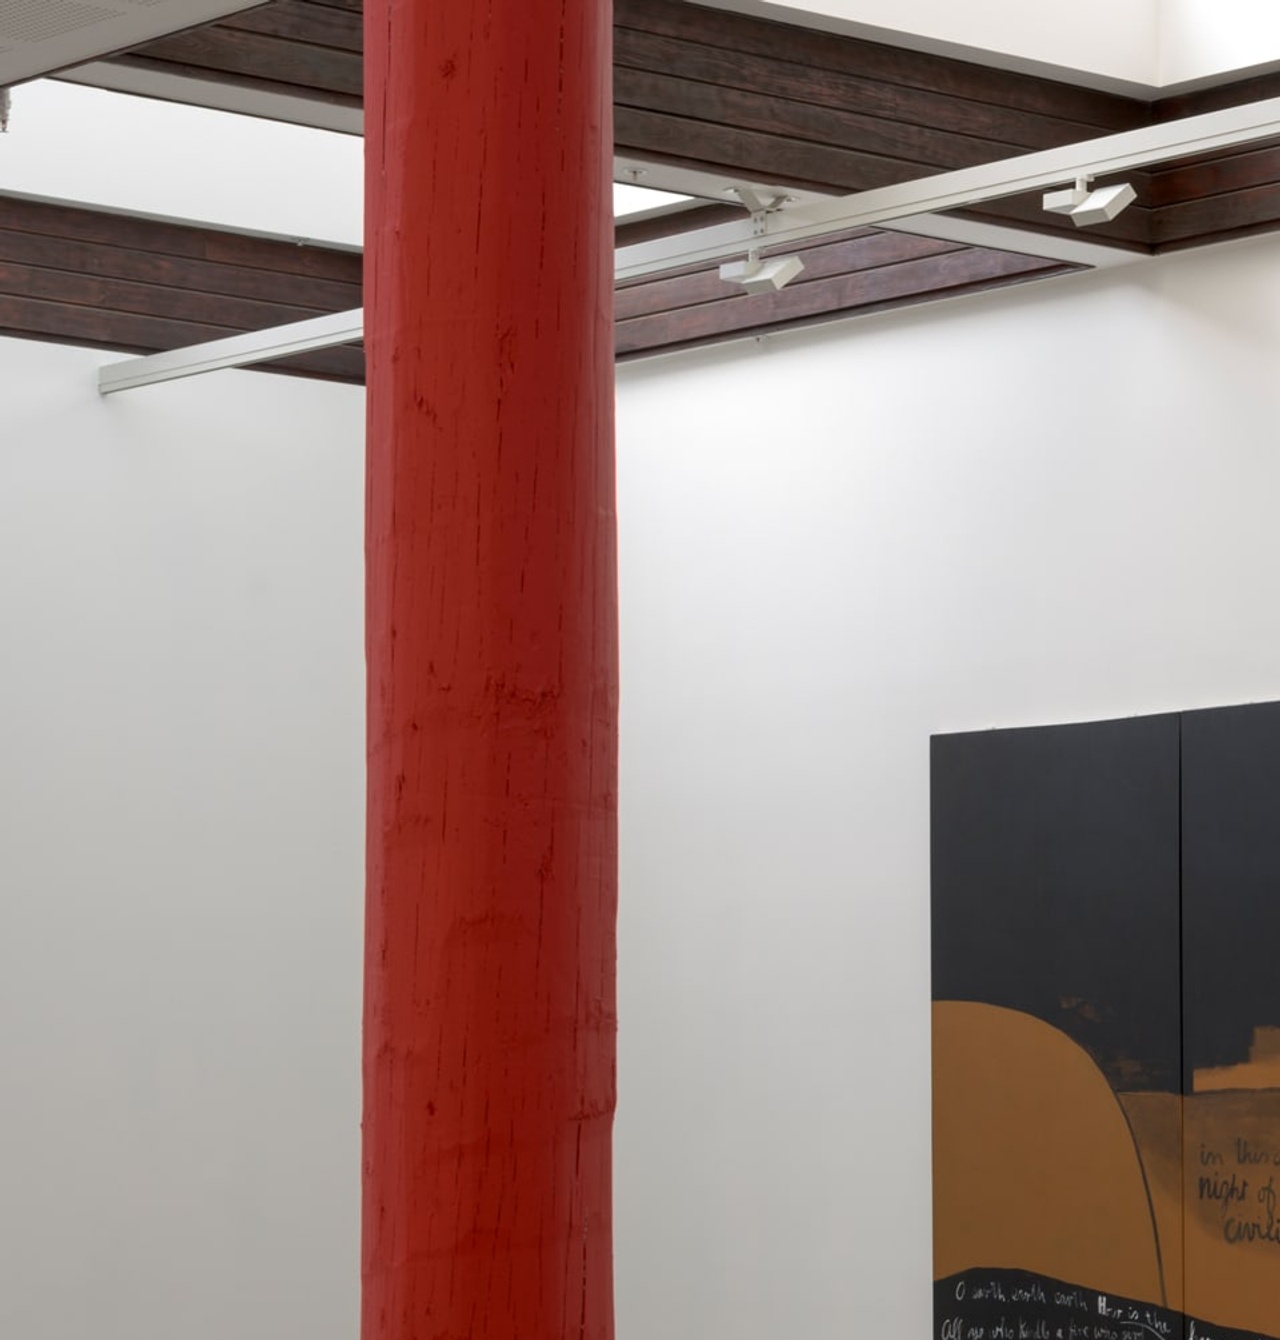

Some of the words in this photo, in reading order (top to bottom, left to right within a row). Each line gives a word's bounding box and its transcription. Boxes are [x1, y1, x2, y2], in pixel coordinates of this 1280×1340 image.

[1199, 1143, 1224, 1166] in
[1235, 1137, 1269, 1166] this
[1198, 1172, 1248, 1219] night
[1257, 1175, 1276, 1222] of
[956, 1280, 966, 1300] O
[1054, 1287, 1088, 1311] earth
[1128, 1306, 1139, 1320] is
[1146, 1311, 1172, 1333] the
